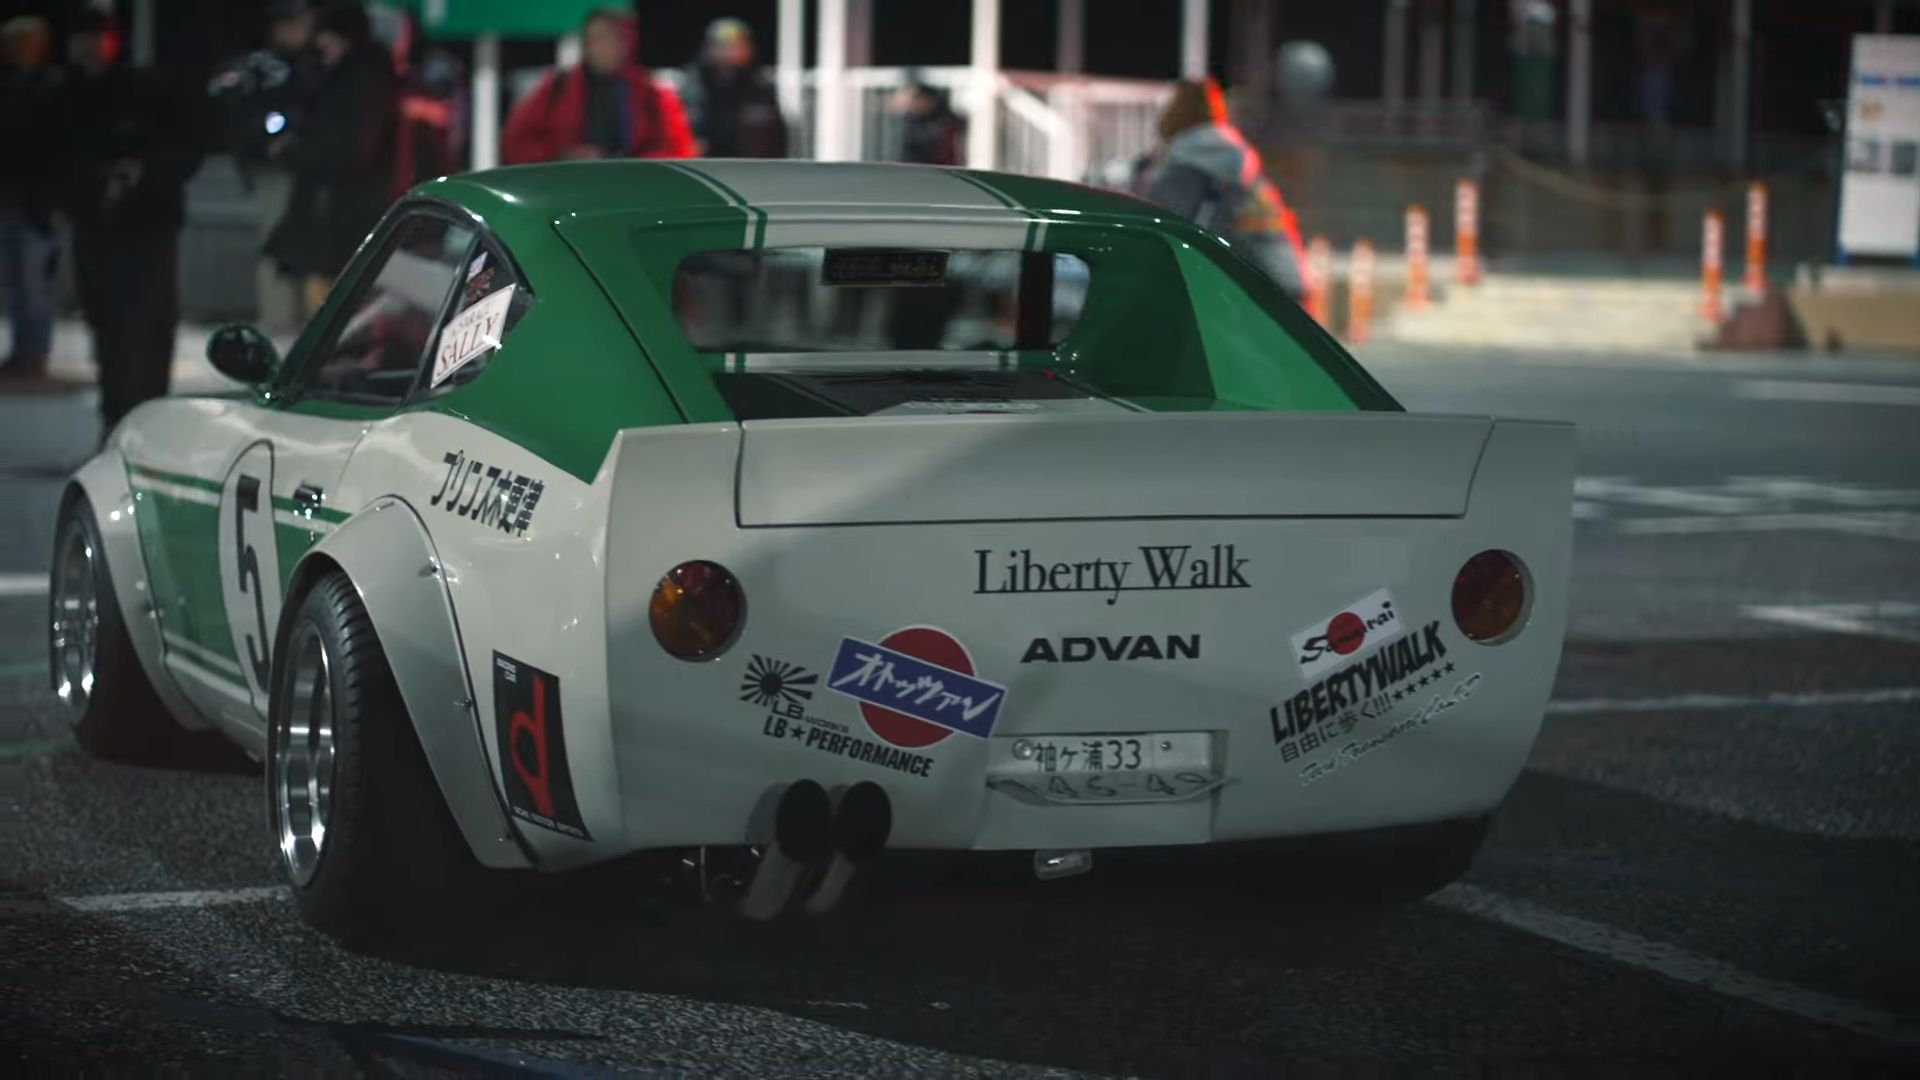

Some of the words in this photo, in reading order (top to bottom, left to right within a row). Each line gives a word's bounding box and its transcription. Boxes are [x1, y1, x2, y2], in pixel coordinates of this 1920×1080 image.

[437, 312, 500, 376] SALLY
[236, 473, 271, 690] 5
[974, 548, 1132, 605] Liberty
[1138, 544, 1252, 589] Walk
[1020, 634, 1200, 663] ADVAN
[1300, 600, 1396, 665] Sarai
[771, 699, 805, 720] LB
[1269, 620, 1447, 745] LIBERTYWALK
